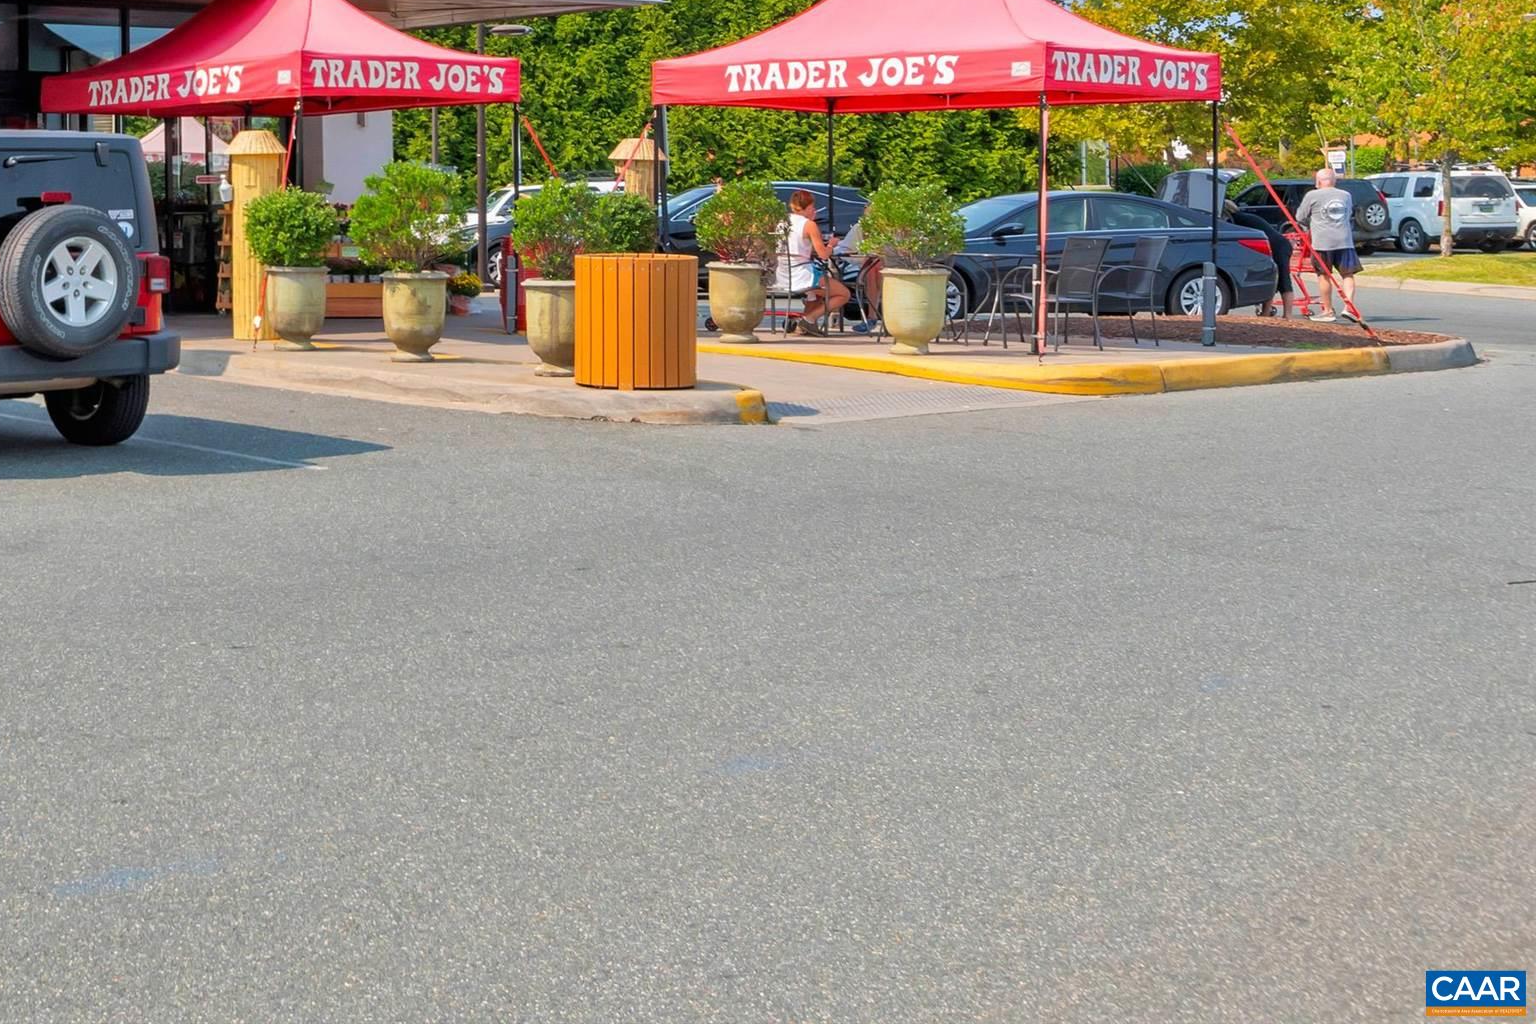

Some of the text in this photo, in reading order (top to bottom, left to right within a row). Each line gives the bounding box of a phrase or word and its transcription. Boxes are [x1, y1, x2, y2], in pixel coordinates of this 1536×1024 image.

[87, 65, 244, 107] TRADER JOE'S
[309, 59, 506, 94] TRADER JOE'S
[724, 54, 960, 92] TRADER JOE'S
[1052, 51, 1209, 92] TRADER JOE'S
